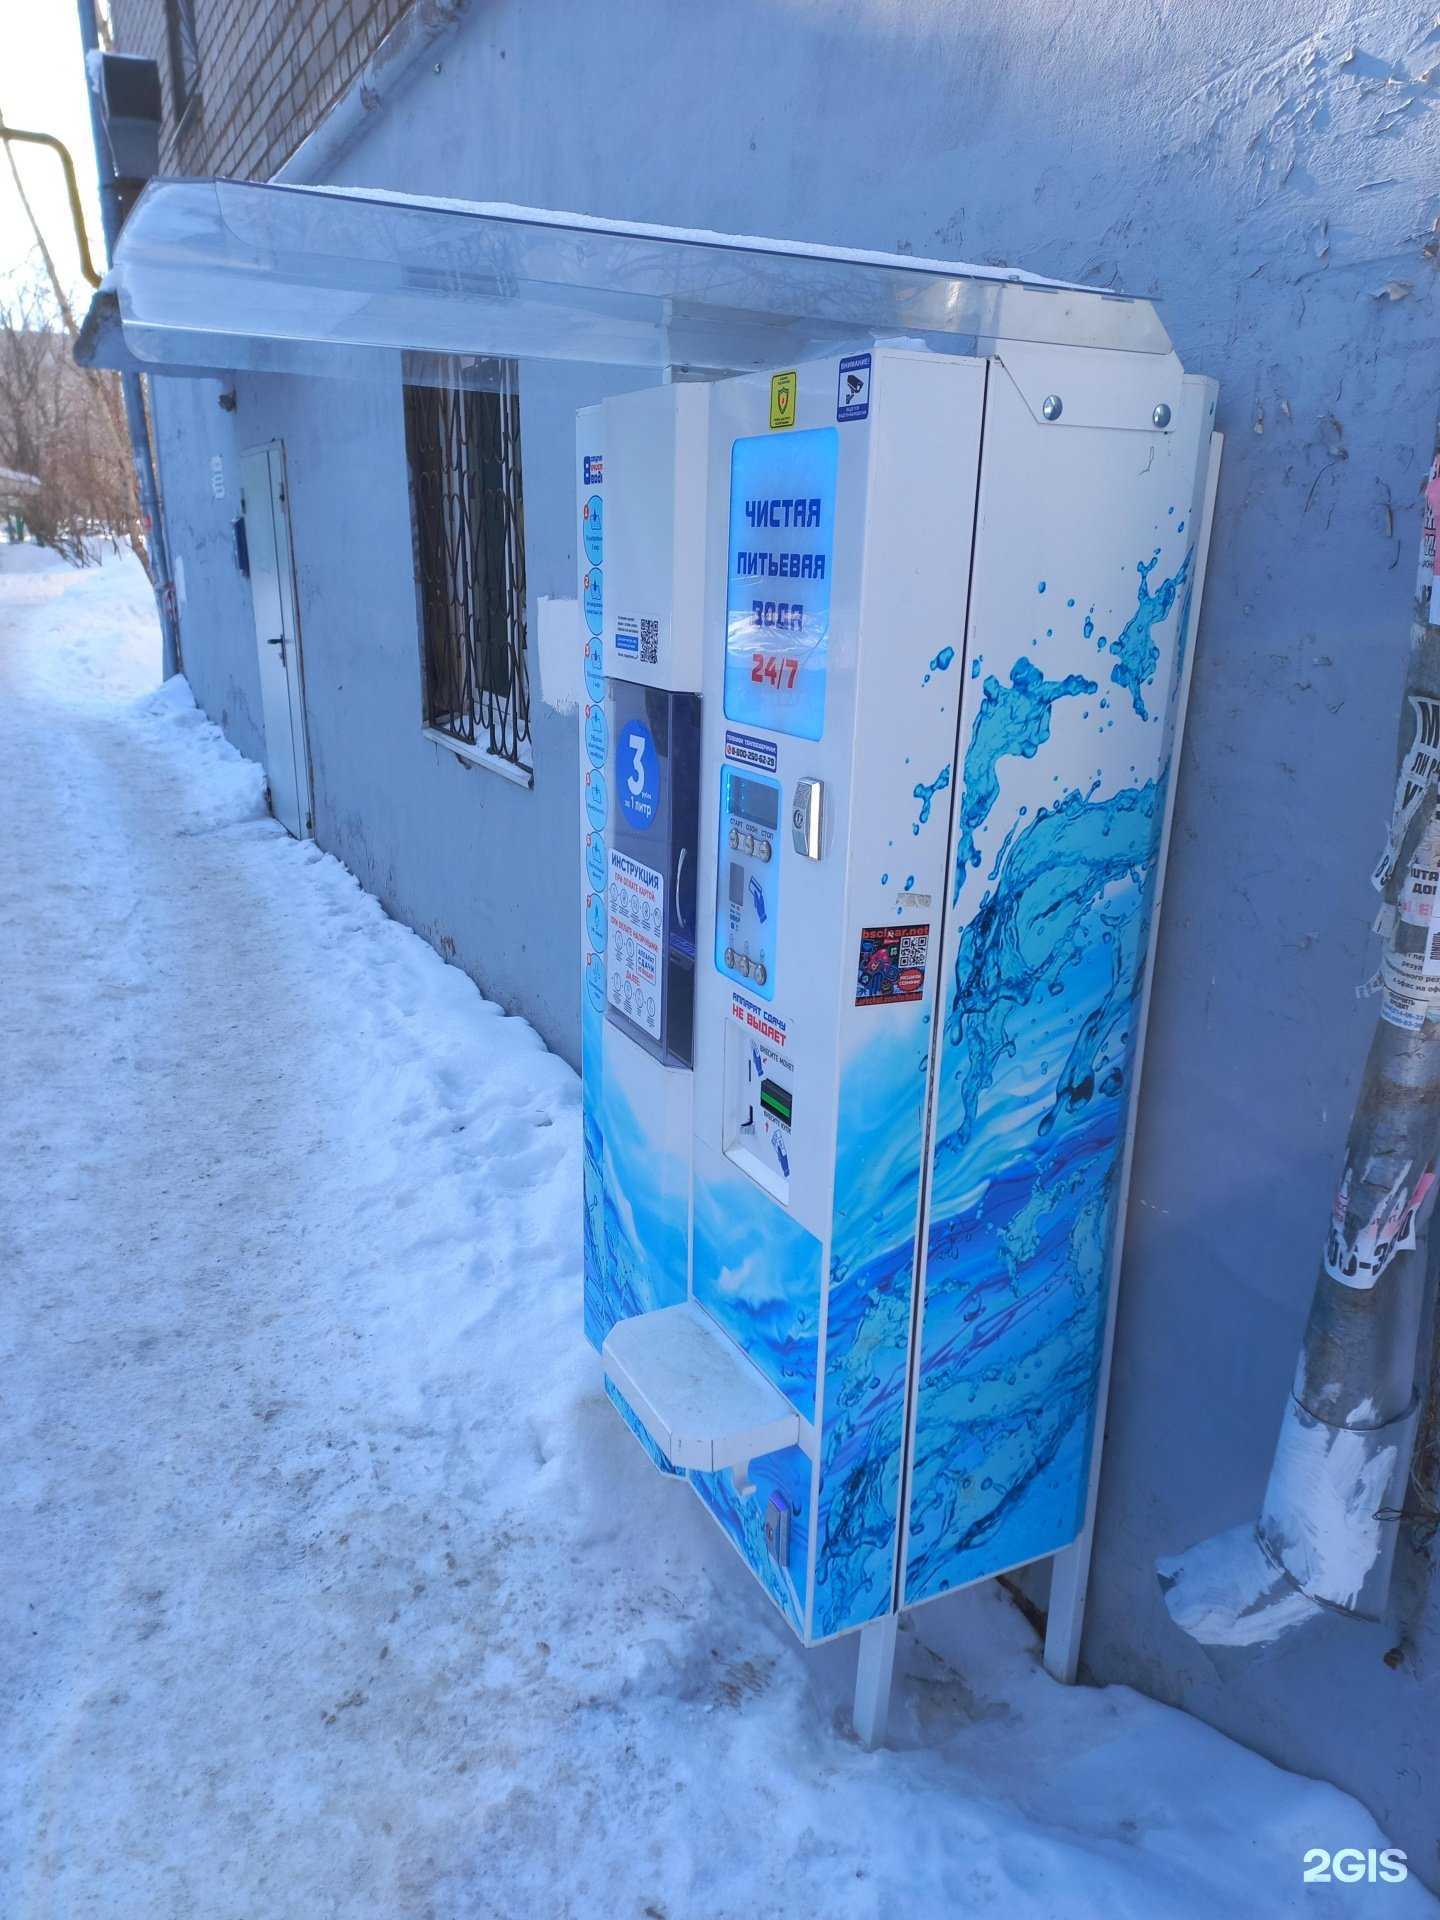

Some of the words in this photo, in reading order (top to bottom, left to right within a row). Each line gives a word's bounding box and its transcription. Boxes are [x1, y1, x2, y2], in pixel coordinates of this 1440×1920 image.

[745, 498, 821, 528] ЧИСТАЯ
[737, 552, 826, 580] ПИТЬЕВАЯ
[752, 653, 799, 690] 24/7
[626, 734, 646, 796] 3
[611, 851, 659, 891] ИНСТРУКЦИЯ
[732, 991, 762, 1016] АППАРАТ
[763, 1010, 786, 1031] СДАЧУ
[732, 1002, 744, 1021] НЕ
[746, 1012, 787, 1047] ВЫДАЕТ
